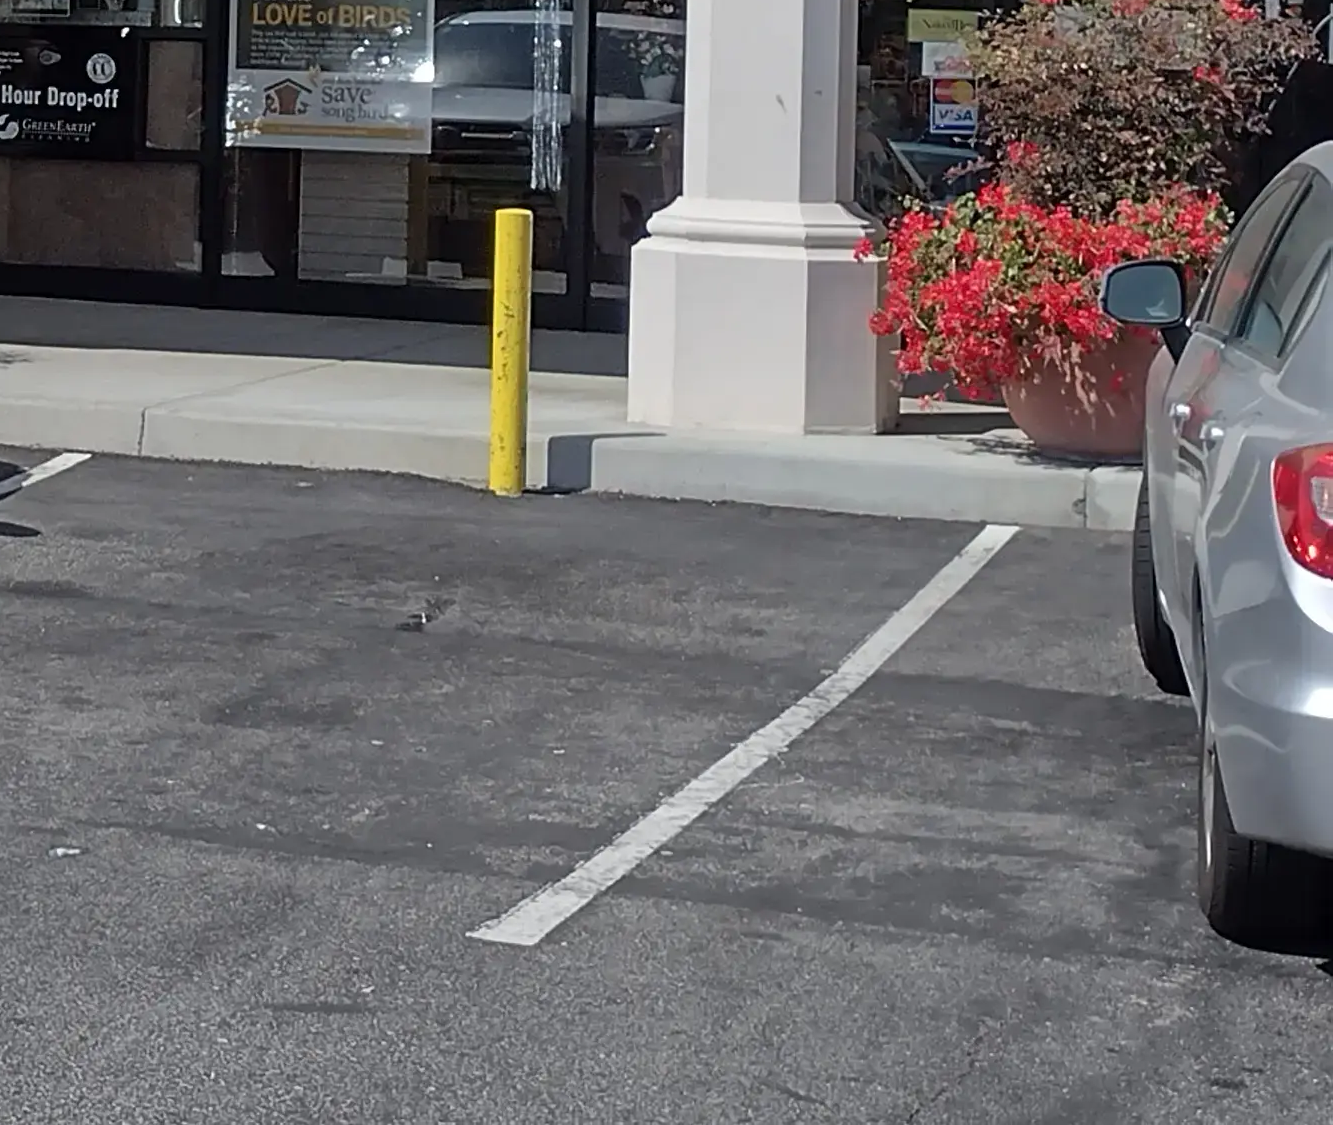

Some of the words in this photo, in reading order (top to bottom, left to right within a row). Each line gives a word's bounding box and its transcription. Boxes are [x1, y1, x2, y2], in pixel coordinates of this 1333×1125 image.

[252, 2, 313, 26] LOVE
[316, 8, 333, 25] of
[338, 4, 412, 28] BIRDS
[1, 84, 42, 105] Hour
[47, 86, 120, 112] Drop-off
[321, 84, 373, 105] save
[321, 106, 356, 123] song
[357, 104, 395, 121] bird
[937, 109, 974, 121] VSA
